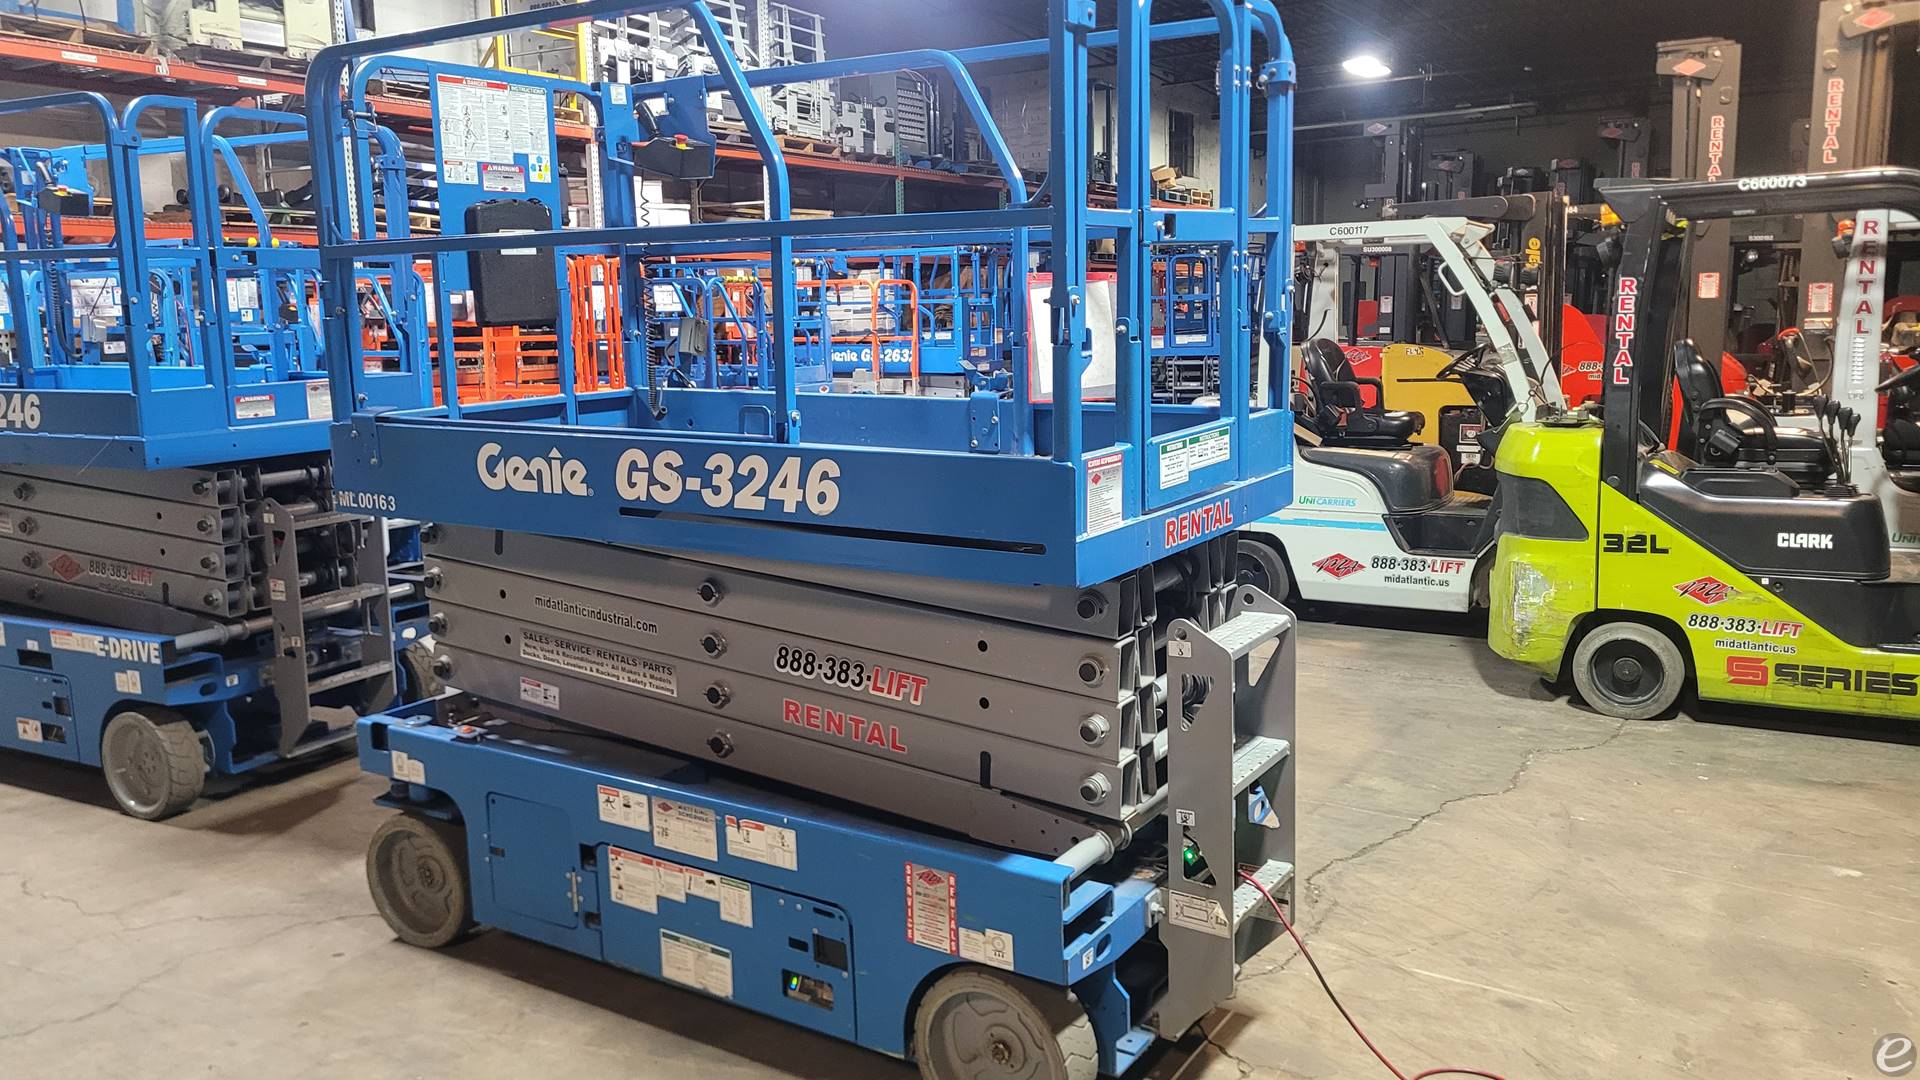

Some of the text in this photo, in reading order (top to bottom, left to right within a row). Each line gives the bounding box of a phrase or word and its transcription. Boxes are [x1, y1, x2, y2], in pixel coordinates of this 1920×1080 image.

[1823, 78, 1844, 163] RENTAL
[1708, 115, 1724, 182] RENTA
[493, 165, 520, 173] WARNING
[1738, 175, 1807, 191] C600073
[1329, 226, 1369, 236] C600117
[1856, 220, 1878, 334] RENTAL
[1613, 277, 1637, 384] RENTAL
[861, 349, 912, 363] G-263
[477, 442, 841, 516] Genie GS-3246
[1165, 499, 1233, 549] RENTAL
[1777, 532, 1833, 549] CLARK
[1603, 533, 1670, 554] 32L
[1384, 574, 1450, 587] midatlantic.us
[534, 596, 658, 634] midatlanticindustrial.com
[96, 636, 161, 665] E-DRIVE
[523, 631, 673, 676] SALES SERVICE RENTALS PARTS
[1715, 638, 1797, 655] midatlantic.us
[1774, 663, 1919, 697] SERIES
[783, 699, 907, 753] RENTAL
